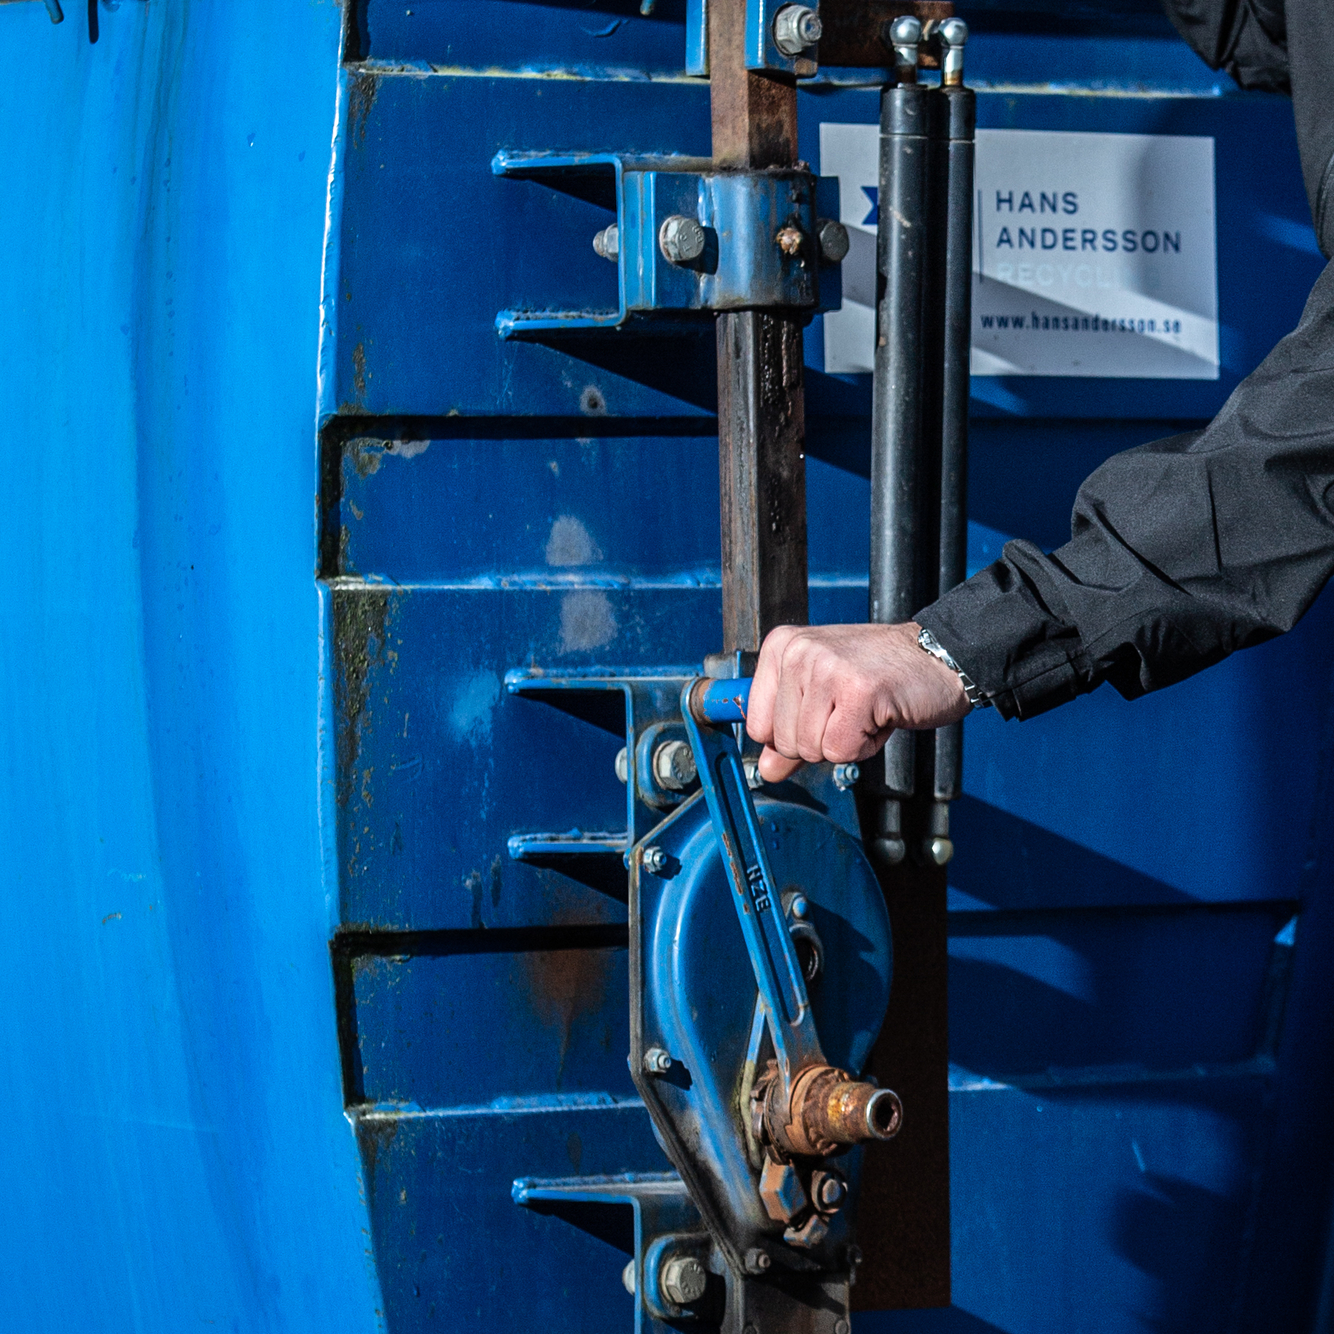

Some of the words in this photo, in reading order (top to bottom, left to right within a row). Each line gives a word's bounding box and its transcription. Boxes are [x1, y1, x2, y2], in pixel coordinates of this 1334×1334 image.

[995, 190, 1079, 215] HANS
[996, 226, 1182, 254] ANDERSSON
[981, 310, 1182, 335] www.hansandersson.se
